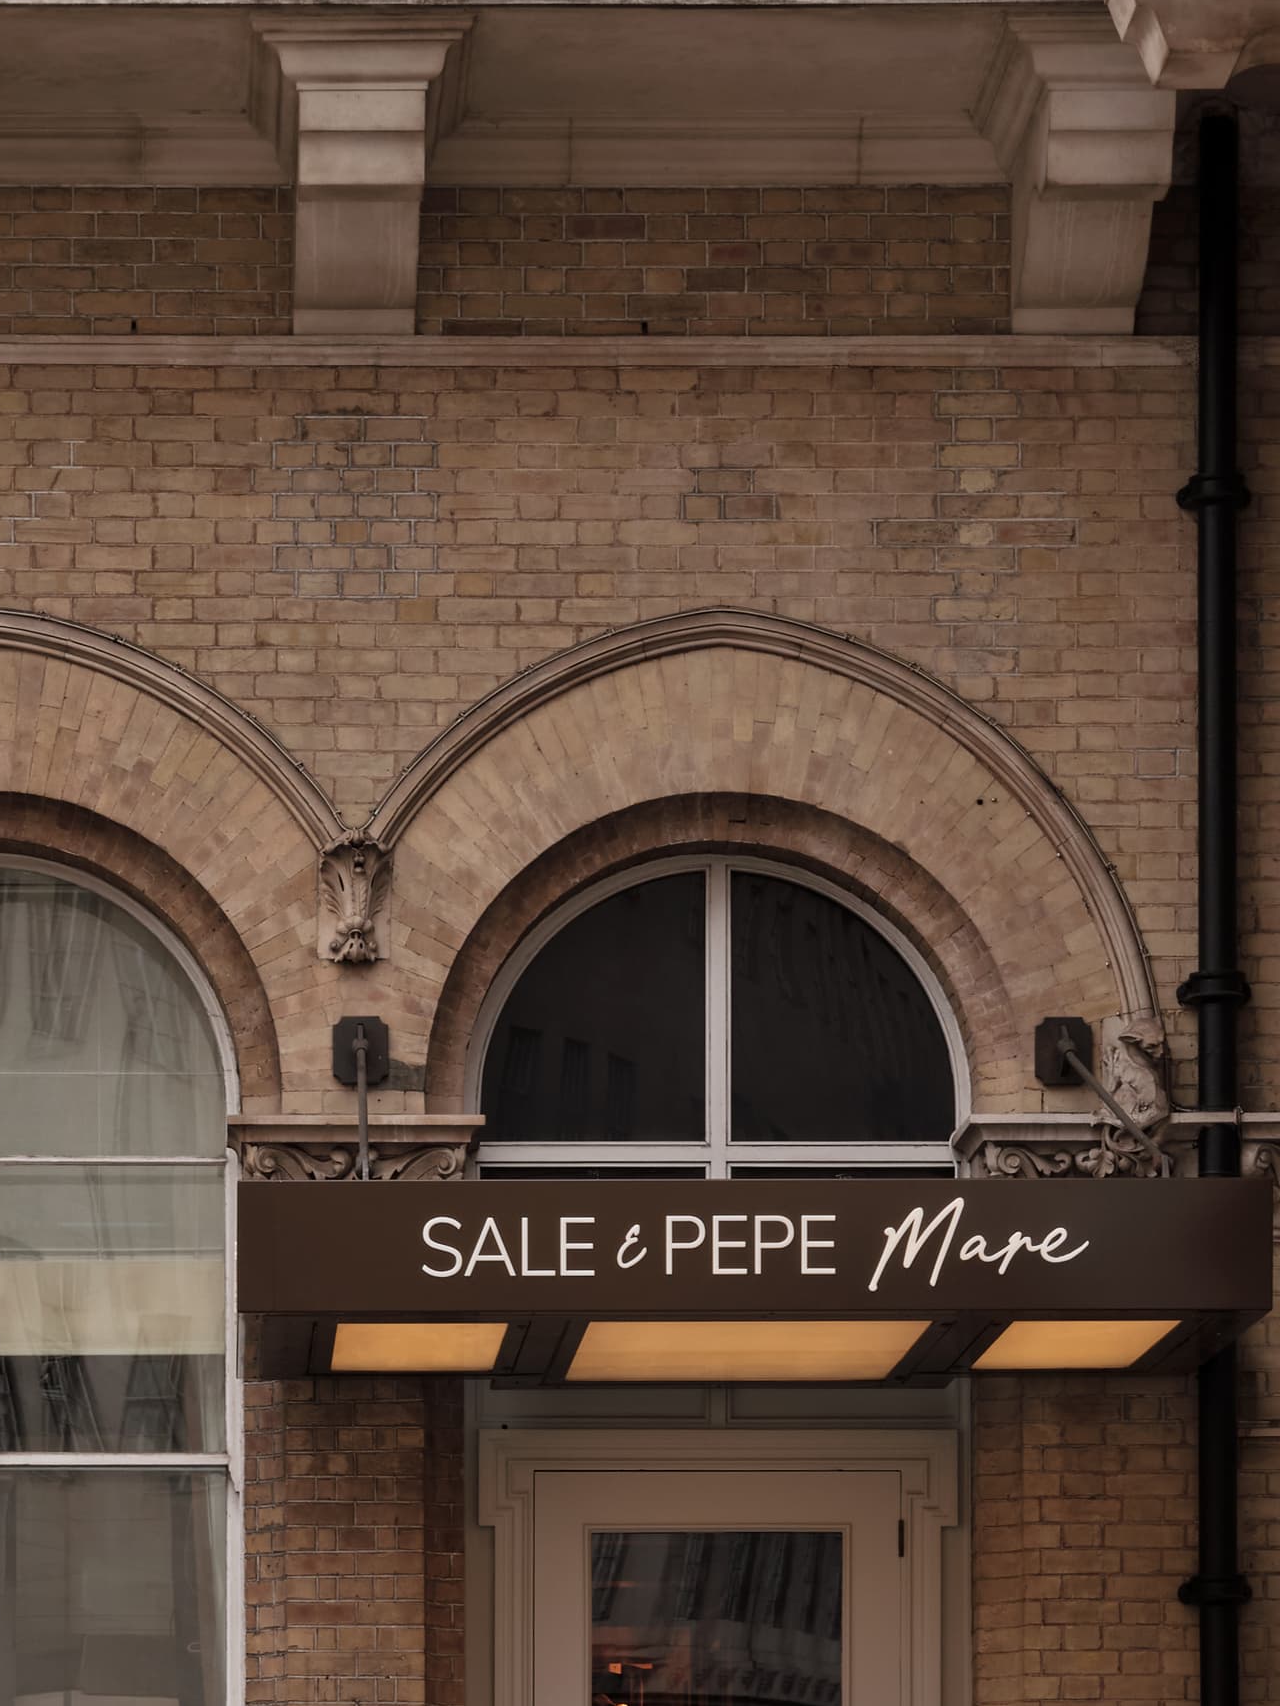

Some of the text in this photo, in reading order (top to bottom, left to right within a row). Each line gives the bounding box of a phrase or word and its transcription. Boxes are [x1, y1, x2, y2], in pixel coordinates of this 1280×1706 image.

[421, 1197, 1090, 1292] SALE & PEPE Mare
